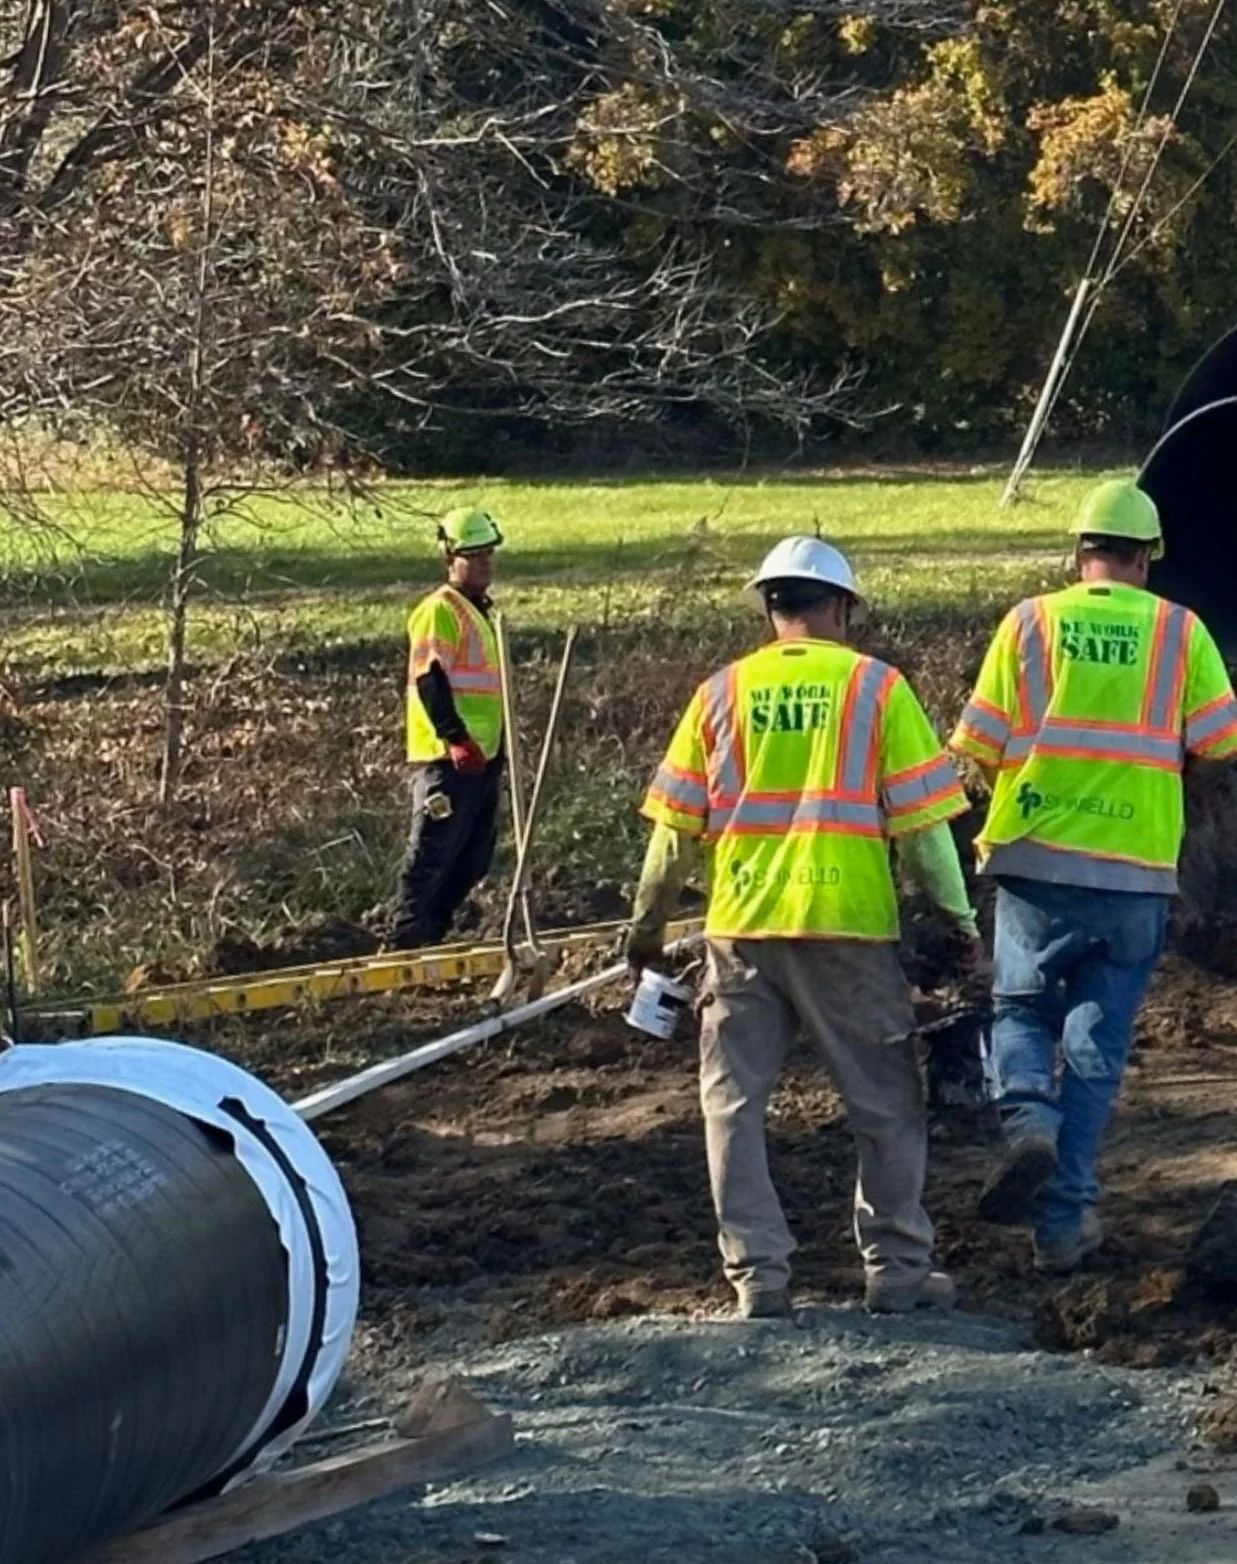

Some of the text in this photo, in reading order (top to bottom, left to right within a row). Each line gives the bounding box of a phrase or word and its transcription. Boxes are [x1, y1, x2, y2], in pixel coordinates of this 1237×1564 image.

[1090, 622, 1140, 637] WORK
[1061, 636, 1137, 665] SAFE
[752, 702, 829, 734] SAFE
